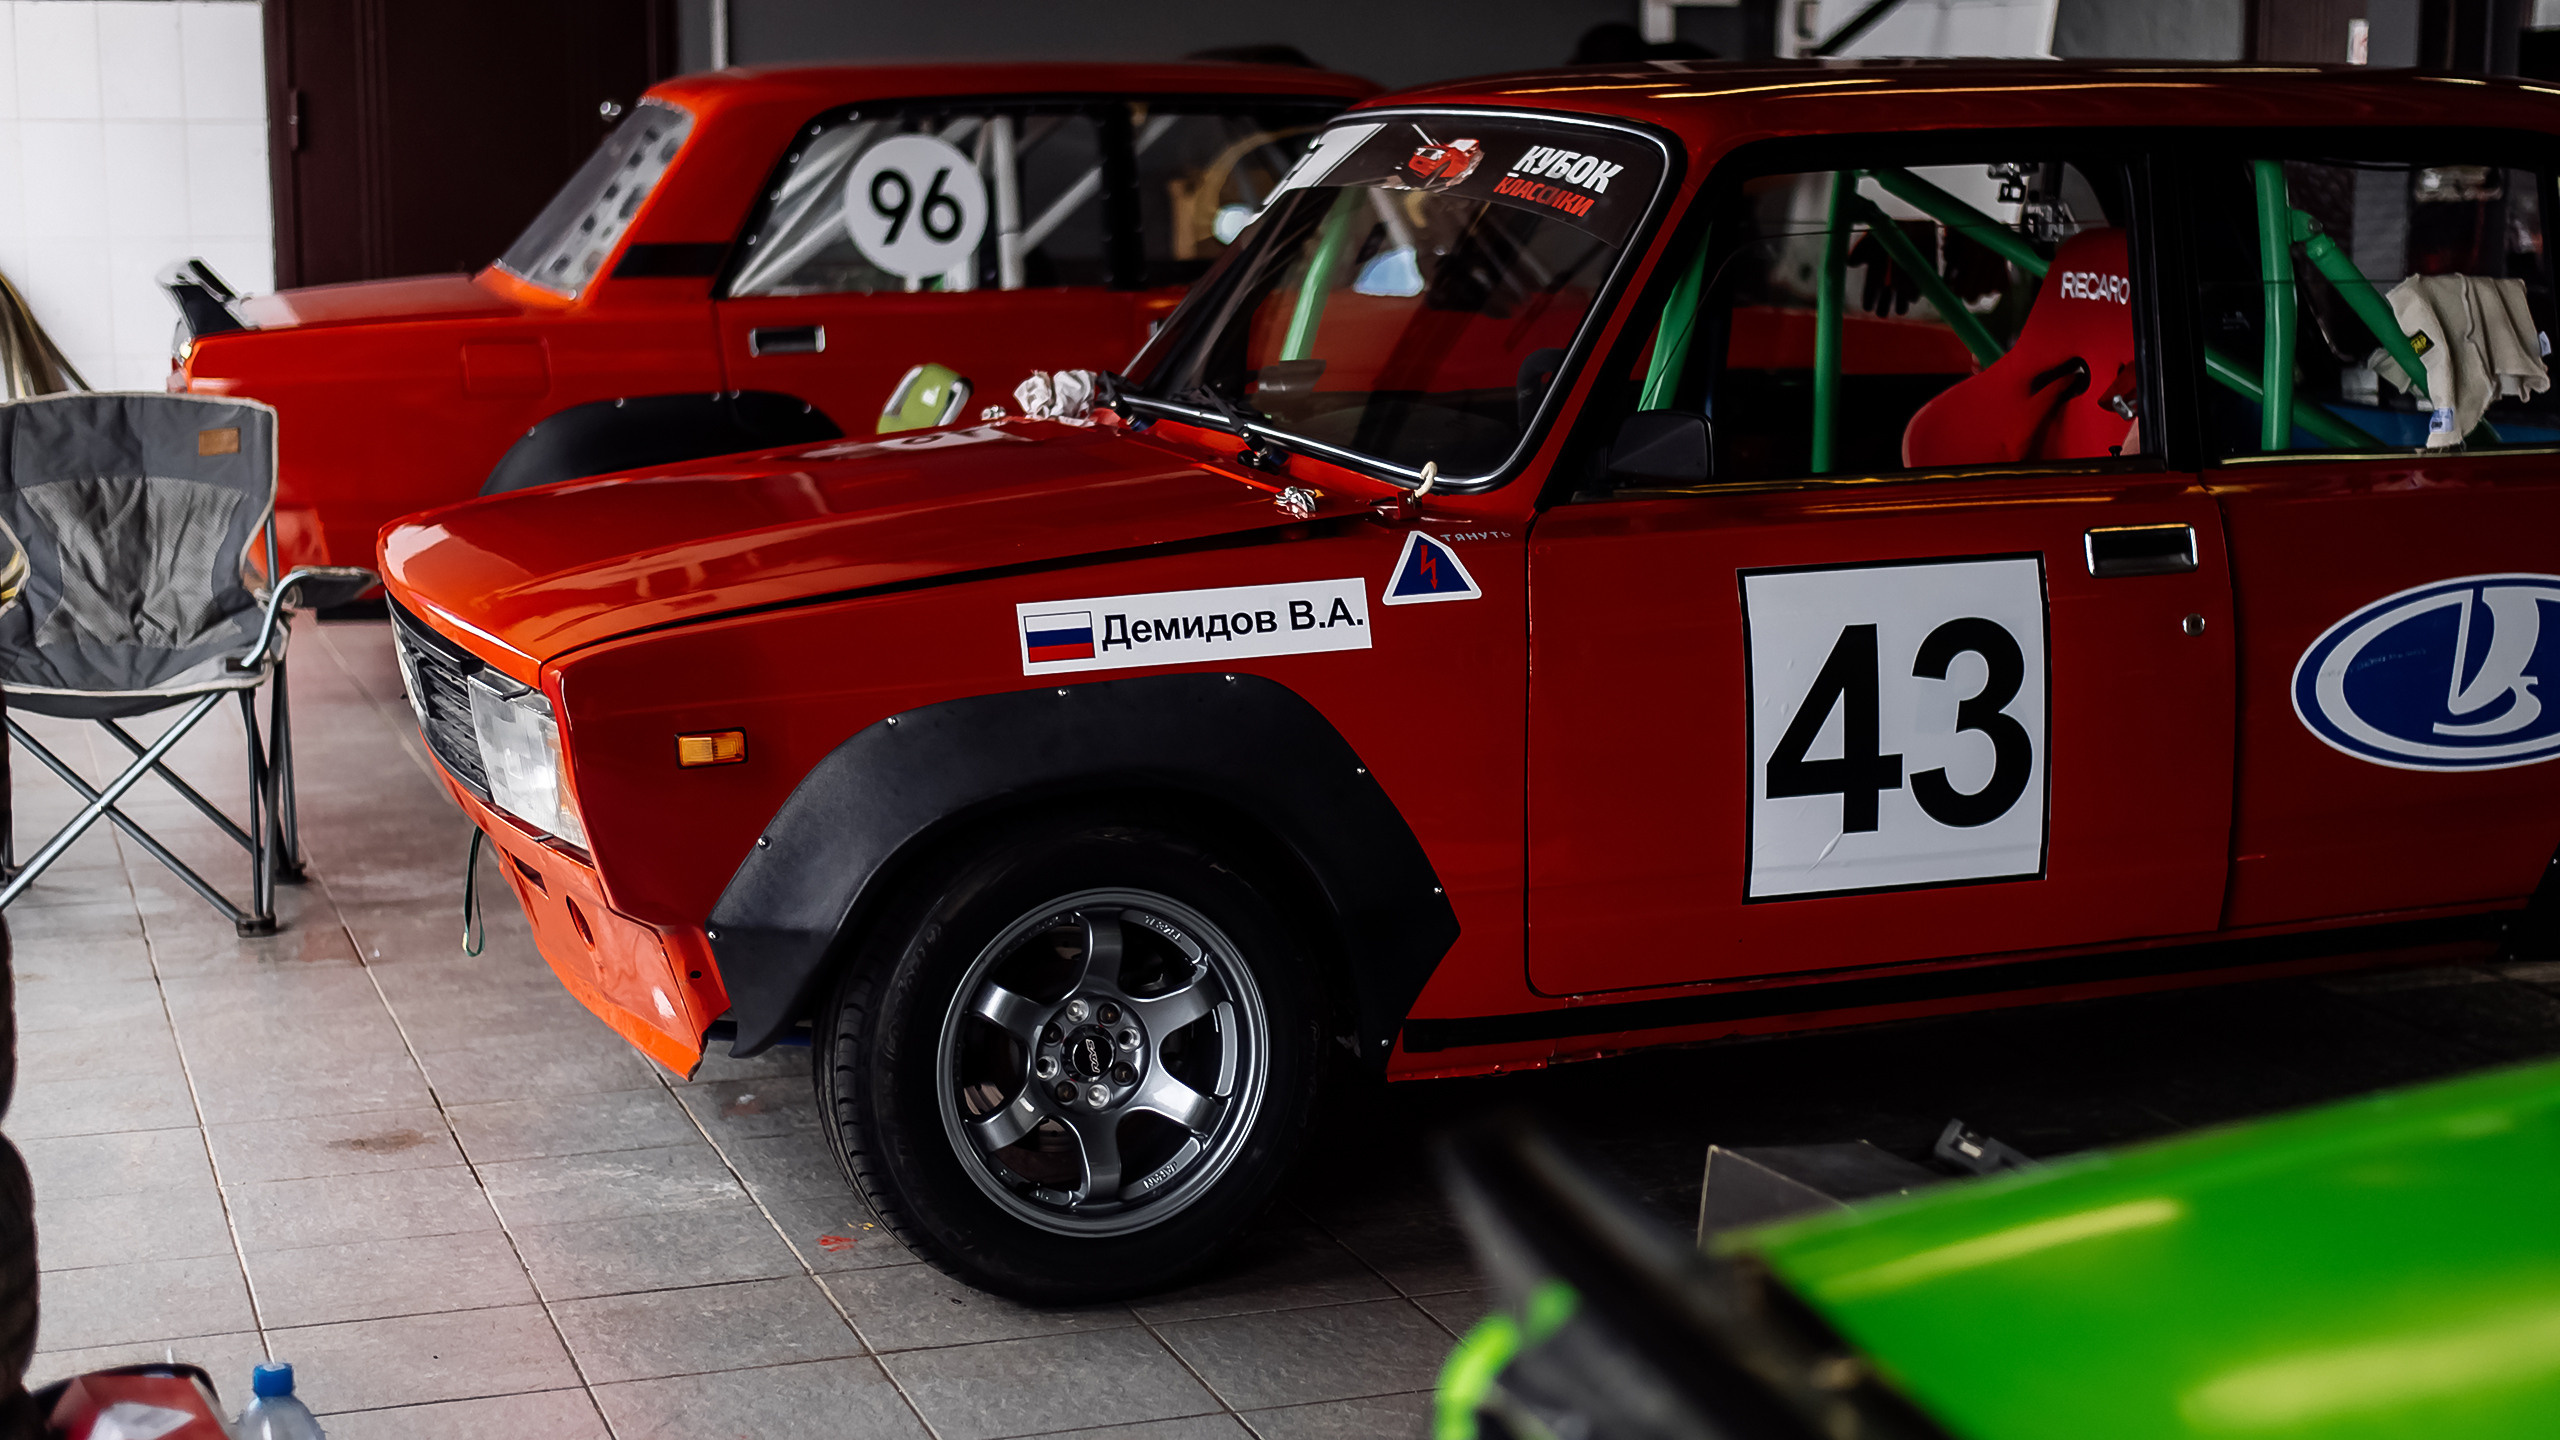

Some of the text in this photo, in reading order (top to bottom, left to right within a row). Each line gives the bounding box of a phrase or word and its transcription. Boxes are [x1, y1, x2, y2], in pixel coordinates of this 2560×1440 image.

[1512, 145, 1624, 194] КУБОК
[870, 168, 964, 246] 96
[1493, 176, 1595, 217] КЛАССИКИ
[2061, 271, 2131, 305] RECARO
[1440, 531, 1511, 542] ТЯНУТЬ
[1102, 597, 1364, 652] Демидов В.А.
[1766, 616, 2033, 834] 43
[1085, 1038, 1101, 1074] RAYS
